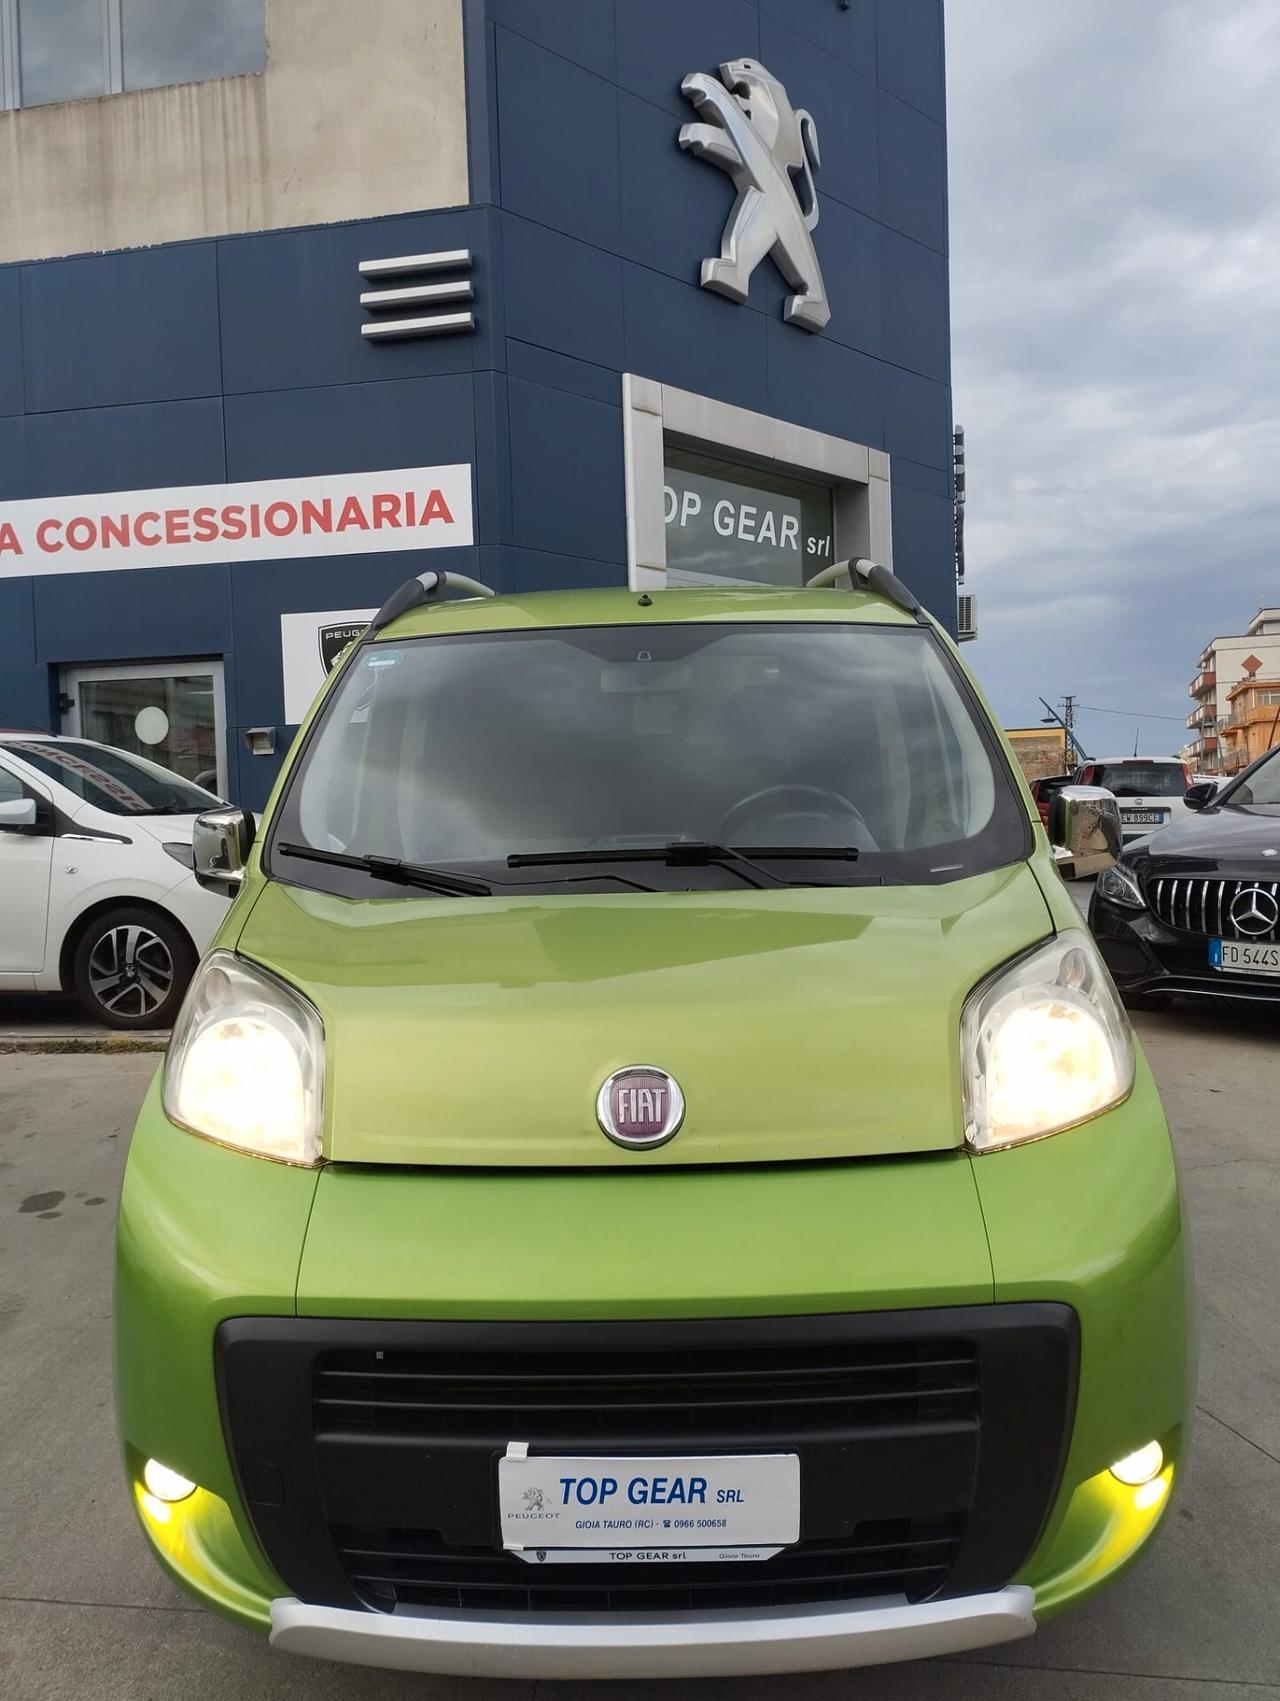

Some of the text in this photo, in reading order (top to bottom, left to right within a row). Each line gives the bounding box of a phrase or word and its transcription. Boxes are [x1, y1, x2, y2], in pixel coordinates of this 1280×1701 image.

[36, 489, 455, 553] CONCESSIONARIA
[664, 486, 830, 557] OP GEAR srl
[325, 629, 364, 640] PEUG
[1222, 945, 1239, 963] FD
[1243, 948, 1279, 966] 544S
[617, 1088, 667, 1124] FIAT
[559, 1477, 745, 1505] TOP GEAR SRL
[575, 1519, 727, 1529] GIOIA TAURO (RC) 0966 500658
[609, 1551, 687, 1560] TOP GEAR srl
